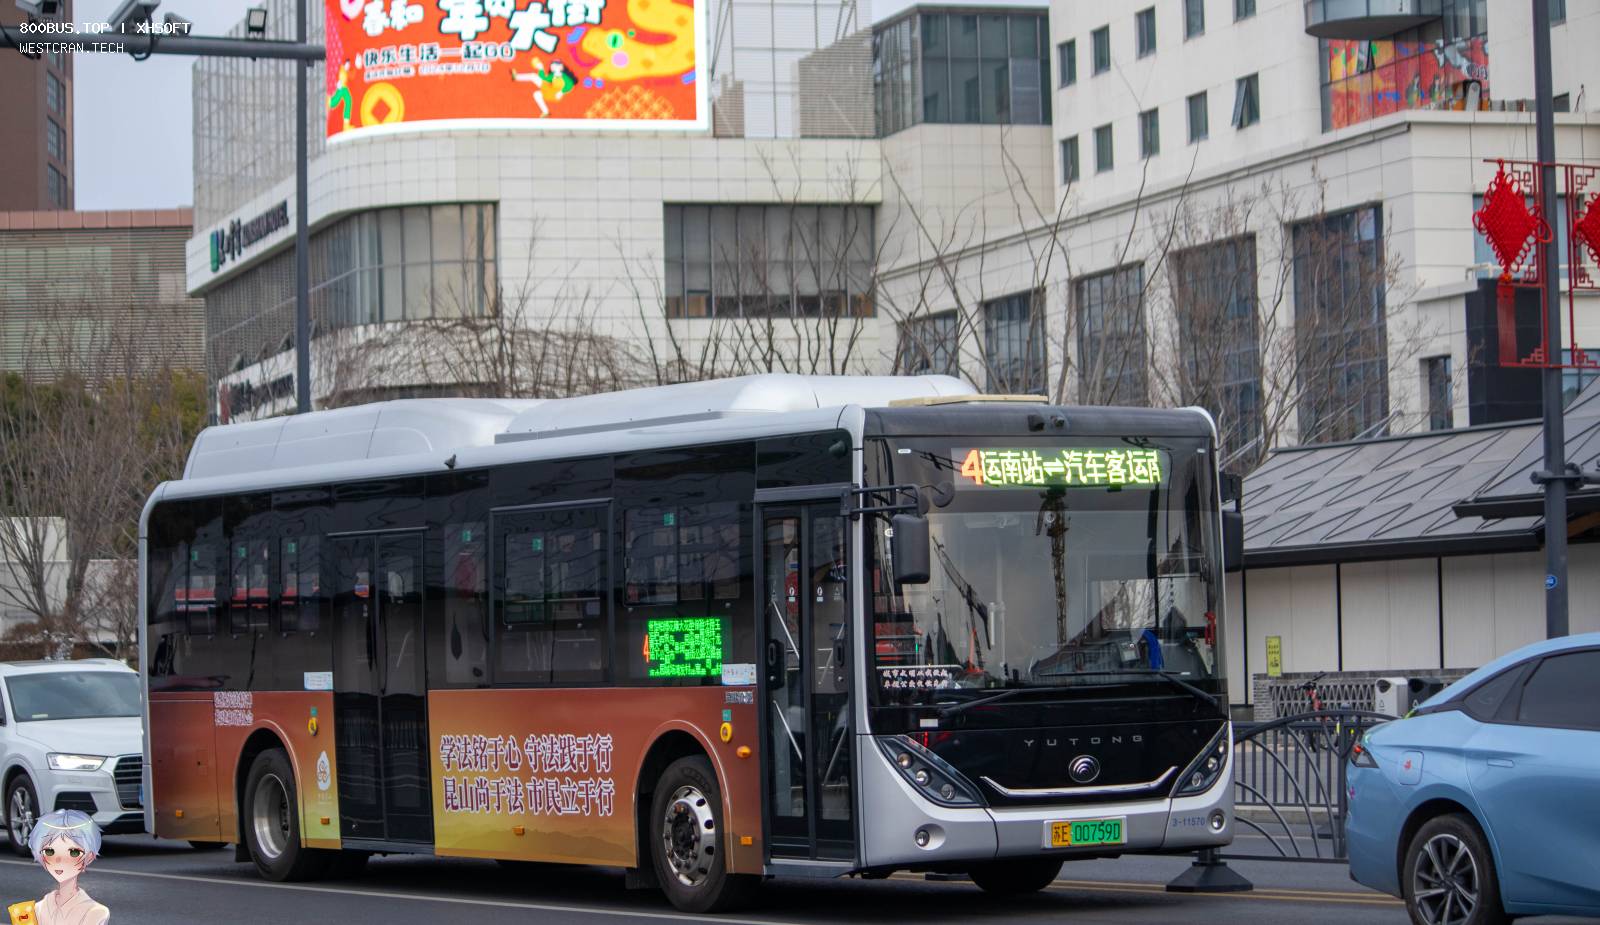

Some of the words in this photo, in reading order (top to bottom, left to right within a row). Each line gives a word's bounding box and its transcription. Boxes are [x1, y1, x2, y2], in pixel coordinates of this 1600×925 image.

[960, 449, 983, 485] 4
[642, 634, 650, 663] 4
[440, 734, 521, 771] 学法铭于心
[525, 734, 613, 771] 守法践于行
[1024, 735, 1143, 747] YUTONG
[443, 776, 525, 815] 昆山尚于法
[526, 776, 615, 815] 市民立于行
